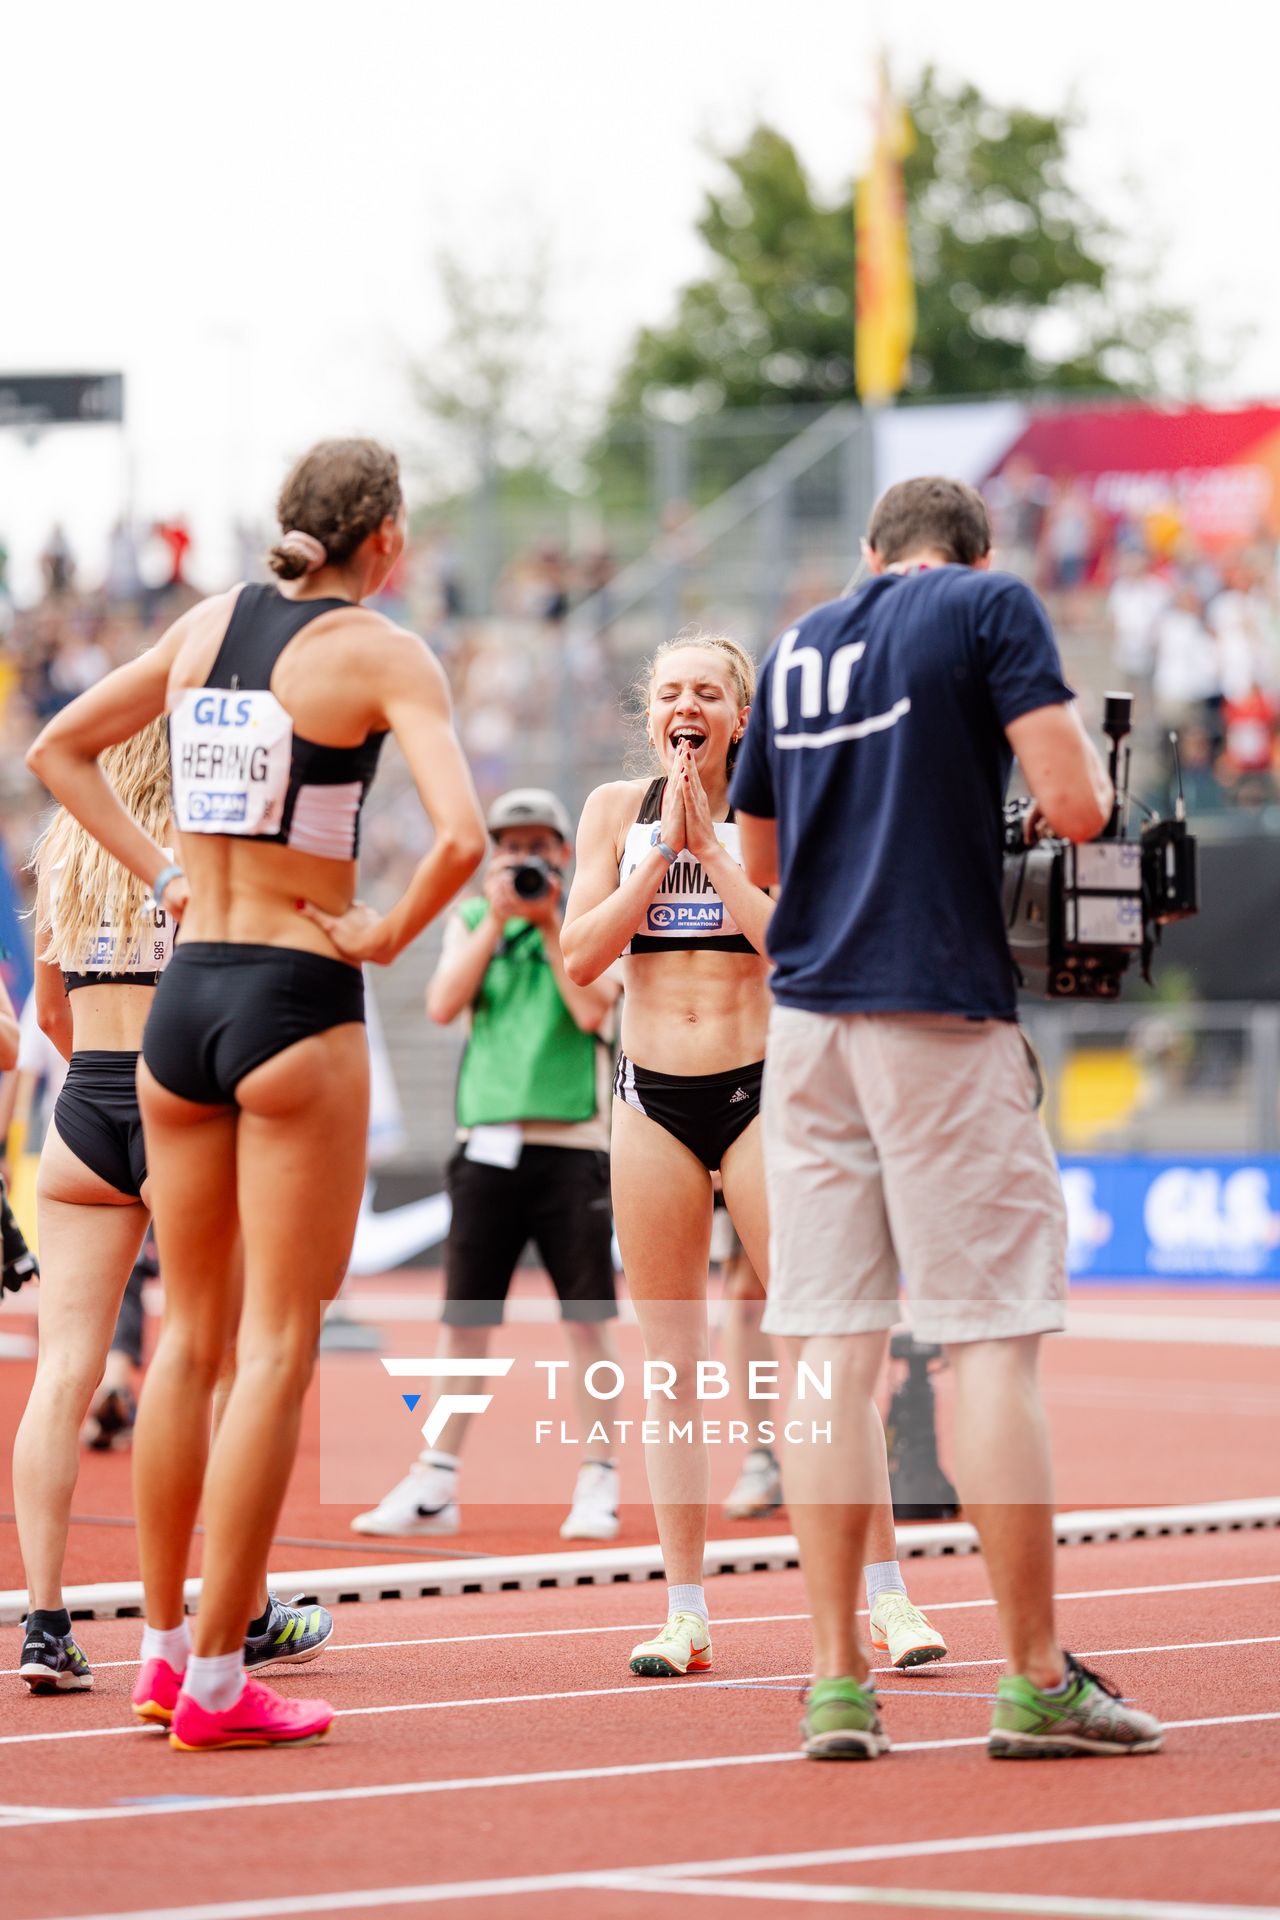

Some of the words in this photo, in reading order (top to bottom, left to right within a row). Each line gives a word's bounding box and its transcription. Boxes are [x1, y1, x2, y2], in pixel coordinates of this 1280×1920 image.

[772, 628, 866, 730] hr
[181, 743, 268, 782] HERING
[677, 908, 720, 920] PLAN
[153, 940, 164, 961] 585
